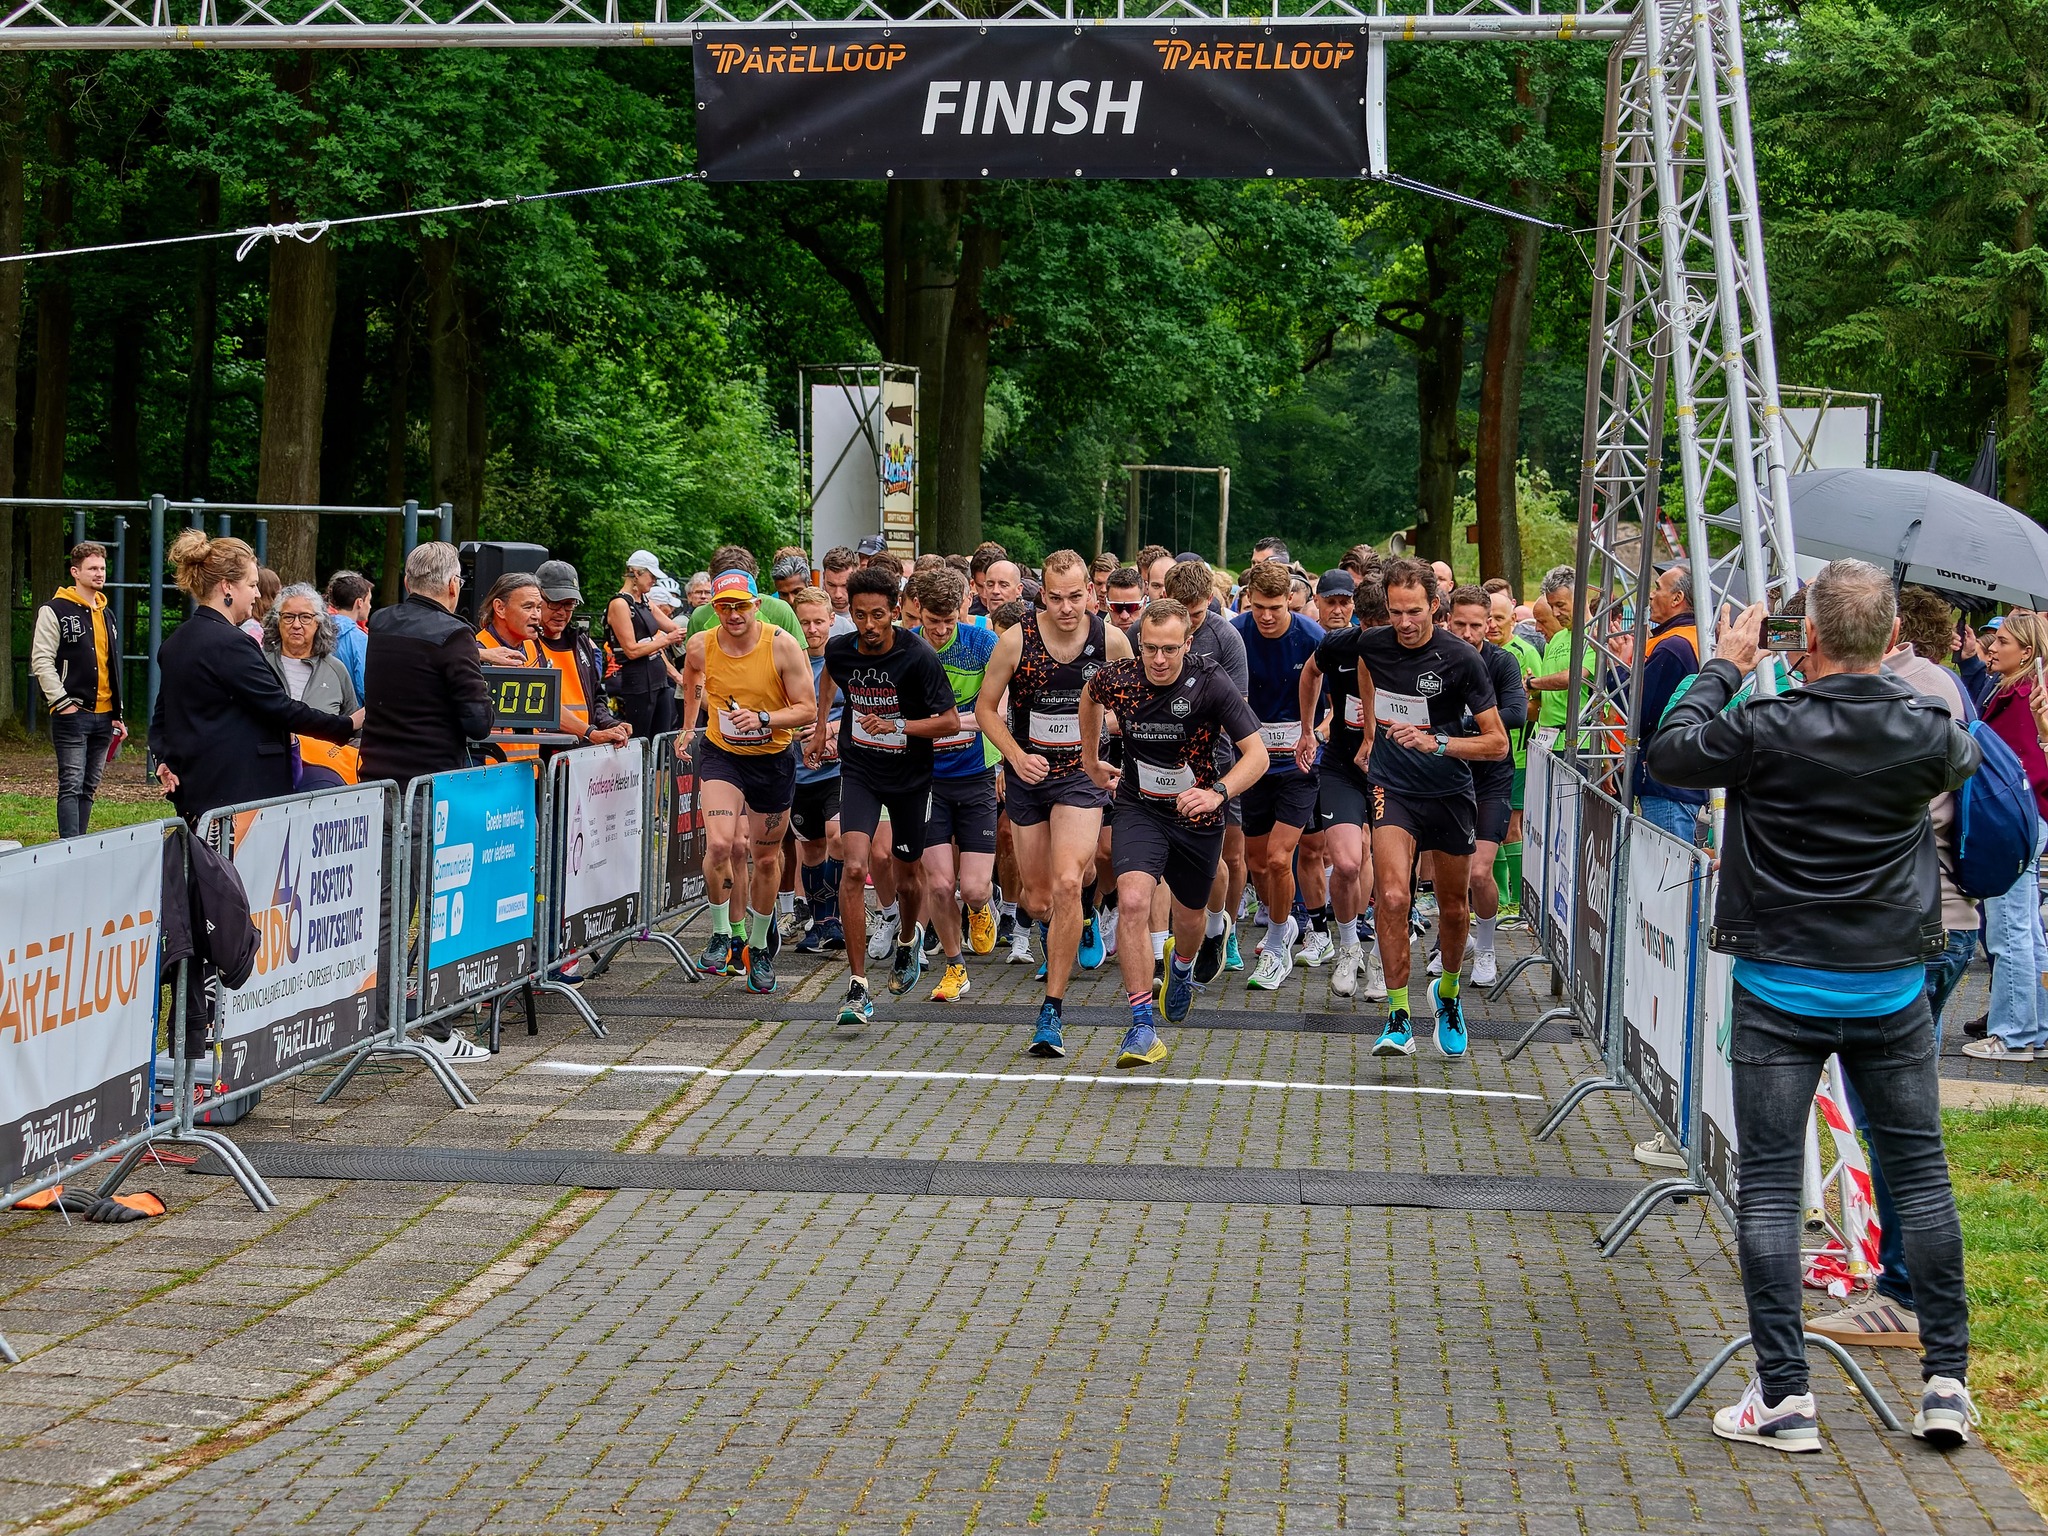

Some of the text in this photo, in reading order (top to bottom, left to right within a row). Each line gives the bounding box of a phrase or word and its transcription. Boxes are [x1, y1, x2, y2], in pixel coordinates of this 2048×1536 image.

[706, 43, 906, 73] PARELLOOP
[1153, 39, 1355, 70] PARELLOOP
[921, 79, 1144, 134] FINISH
[717, 576, 740, 590] HOKA
[1419, 677, 1439, 689] BOON
[484, 681, 546, 713] :00
[848, 685, 897, 697] MARATHON
[850, 695, 899, 706] CHALLENGE
[853, 704, 899, 715] BRUNSSUM
[1390, 702, 1409, 715] 1182
[1048, 724, 1068, 734] 4021
[1268, 731, 1285, 740] 1157
[1132, 732, 1178, 740] endurance
[1155, 776, 1177, 786] 4022
[485, 808, 502, 832] Goede
[312, 815, 369, 859] SPORTPRIJZEN
[0, 909, 154, 1044] ARELLOOP
